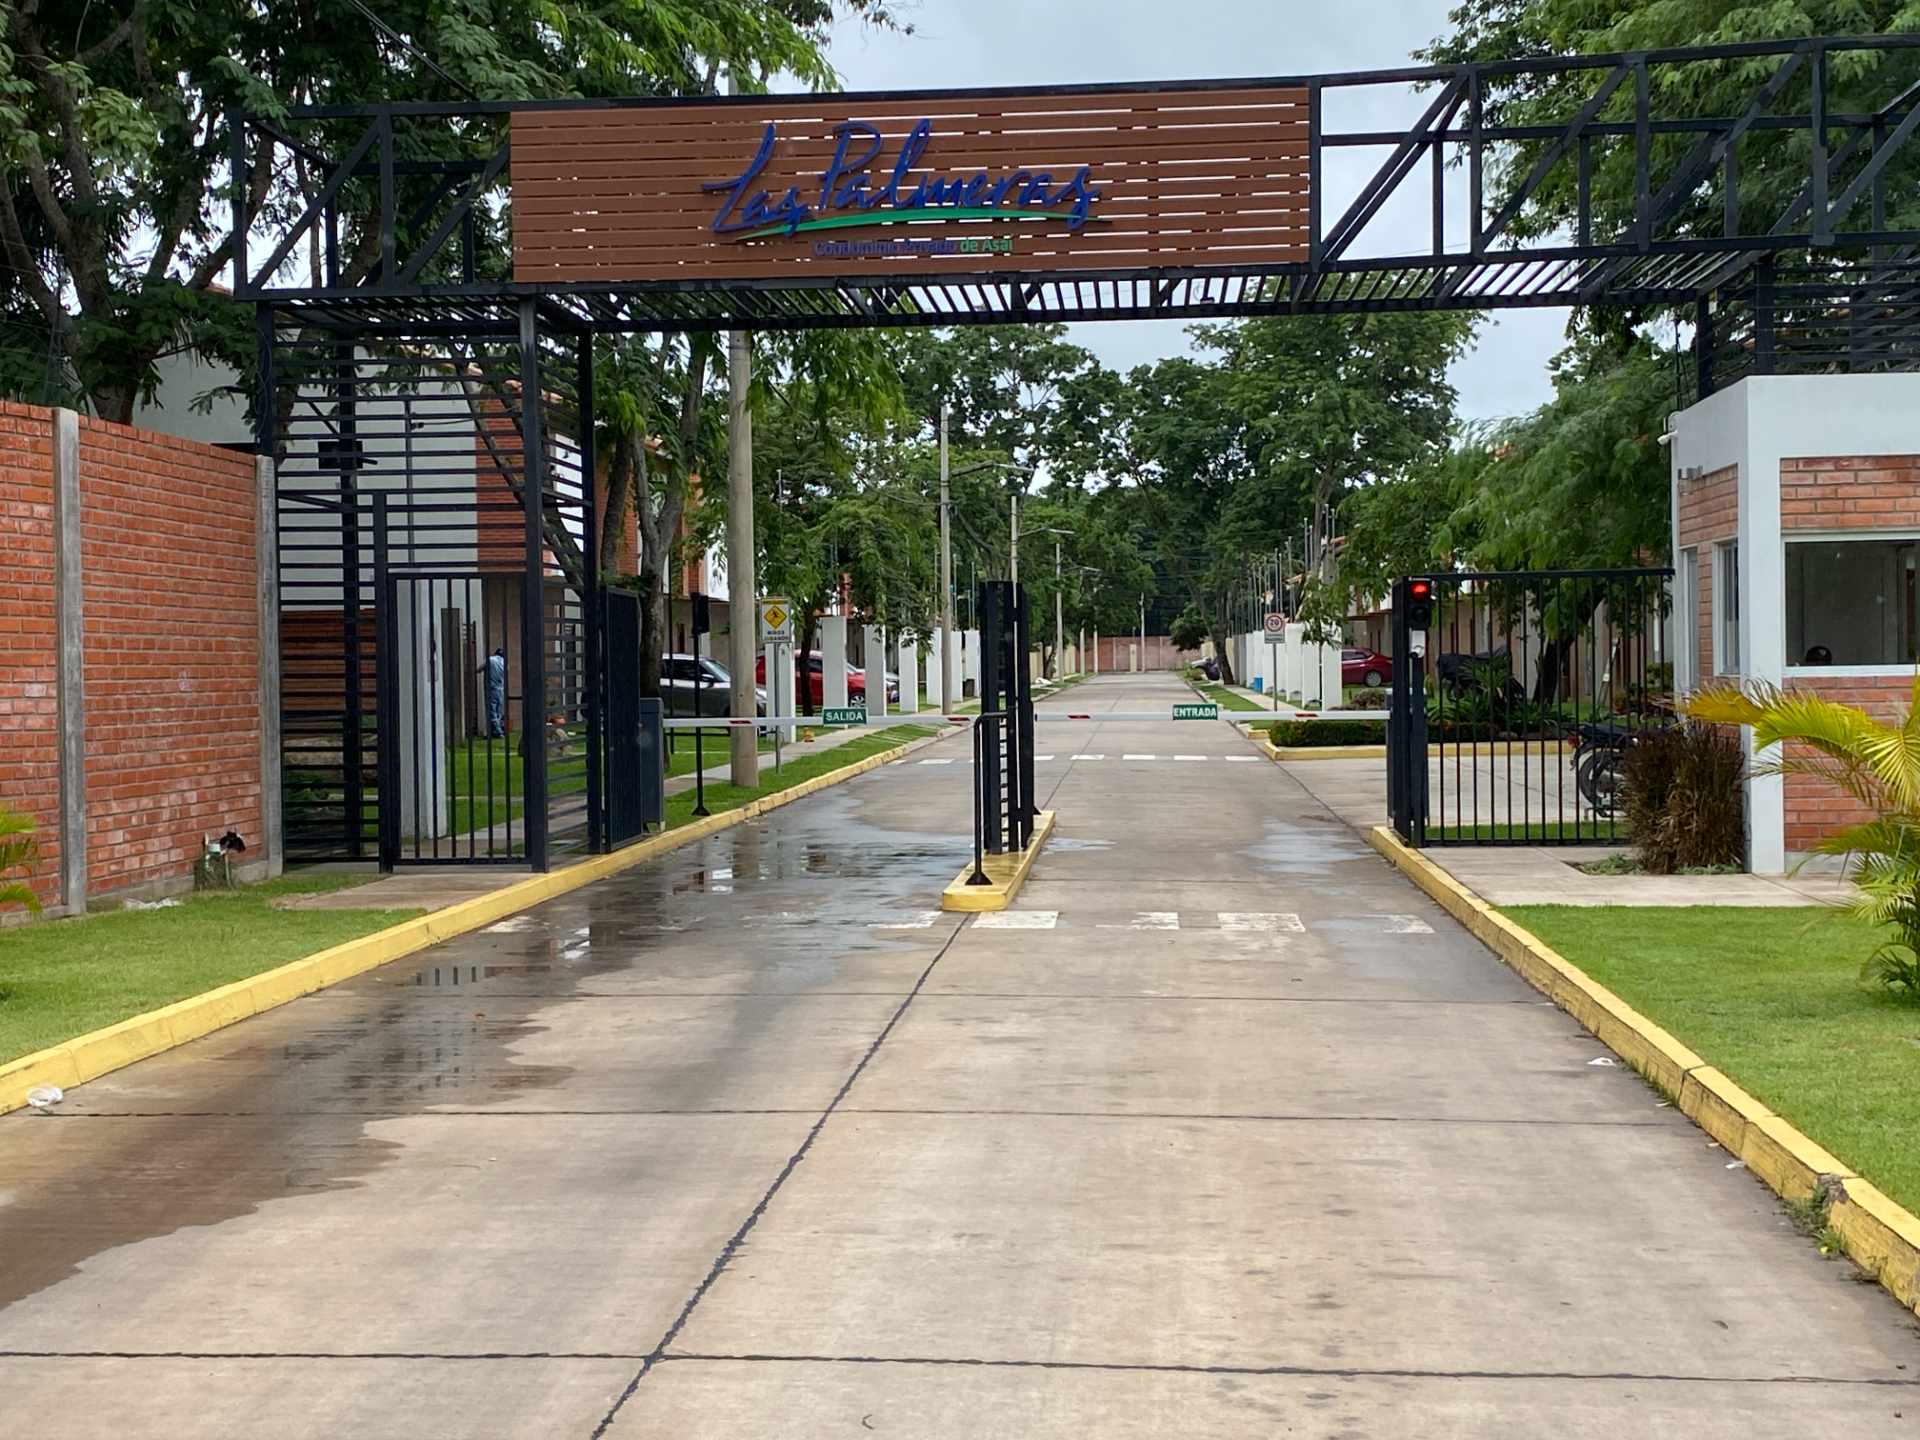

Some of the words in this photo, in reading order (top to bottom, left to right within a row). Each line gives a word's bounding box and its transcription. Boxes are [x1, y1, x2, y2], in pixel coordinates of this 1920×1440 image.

[703, 121, 815, 238] Las
[816, 117, 1101, 231] Palmeras
[960, 237, 978, 253] de
[825, 711, 864, 721] SALIDA
[1173, 707, 1217, 717] ENTRADA
